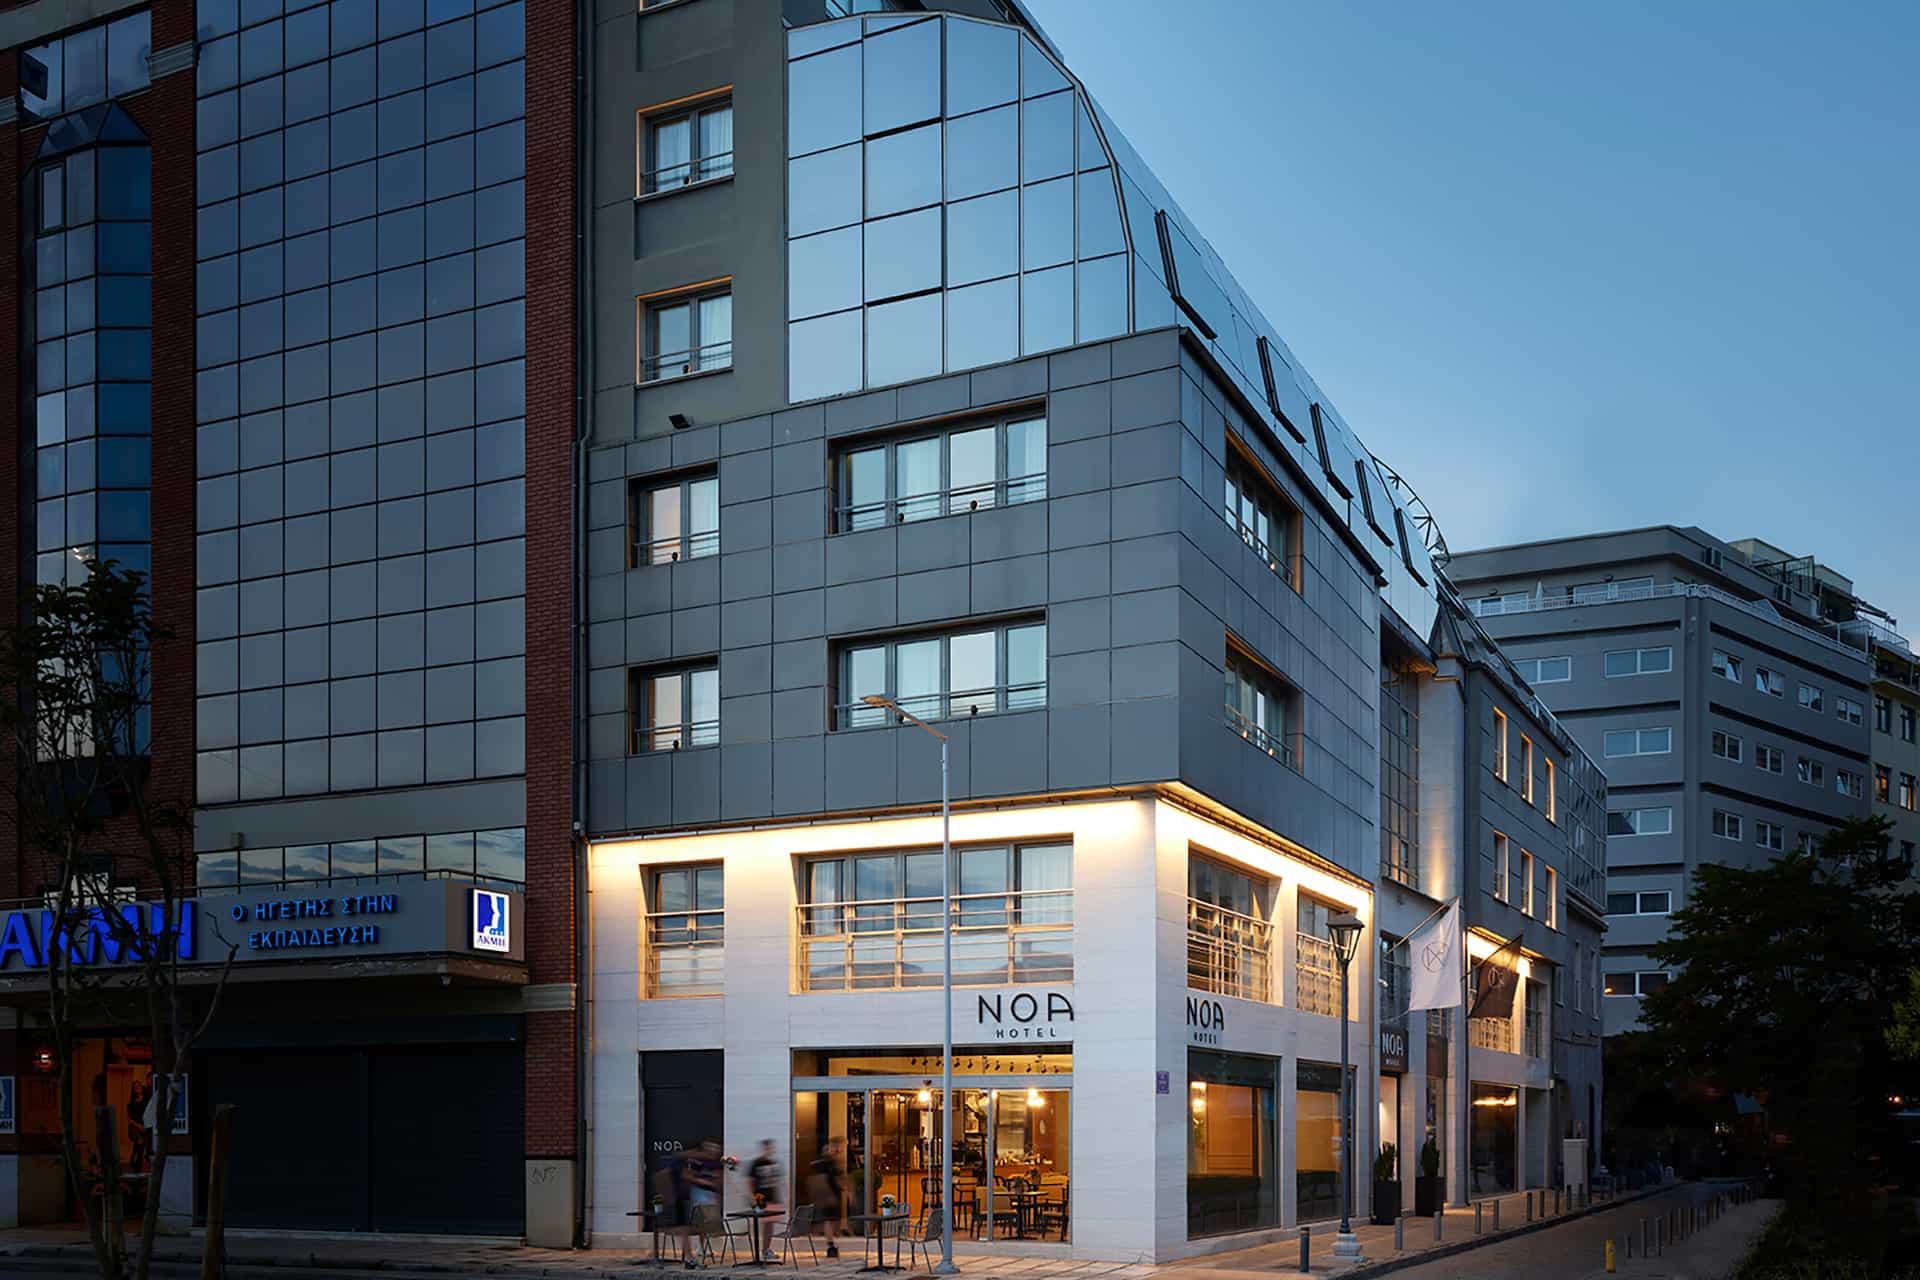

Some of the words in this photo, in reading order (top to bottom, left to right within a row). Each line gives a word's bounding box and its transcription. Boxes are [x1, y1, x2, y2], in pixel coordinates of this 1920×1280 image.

[255, 899, 329, 920] ΗΓΕΤΗΣ
[341, 894, 394, 914] ΣΤΗΝ
[248, 926, 375, 950] ΕΚΠΑΙΔΕΥΣΗ
[978, 992, 1075, 1024] NOA
[1186, 996, 1225, 1031] NOA
[996, 1027, 1057, 1039] HOTEL
[1382, 1032, 1404, 1057] NOA
[653, 1140, 683, 1152] NOA
